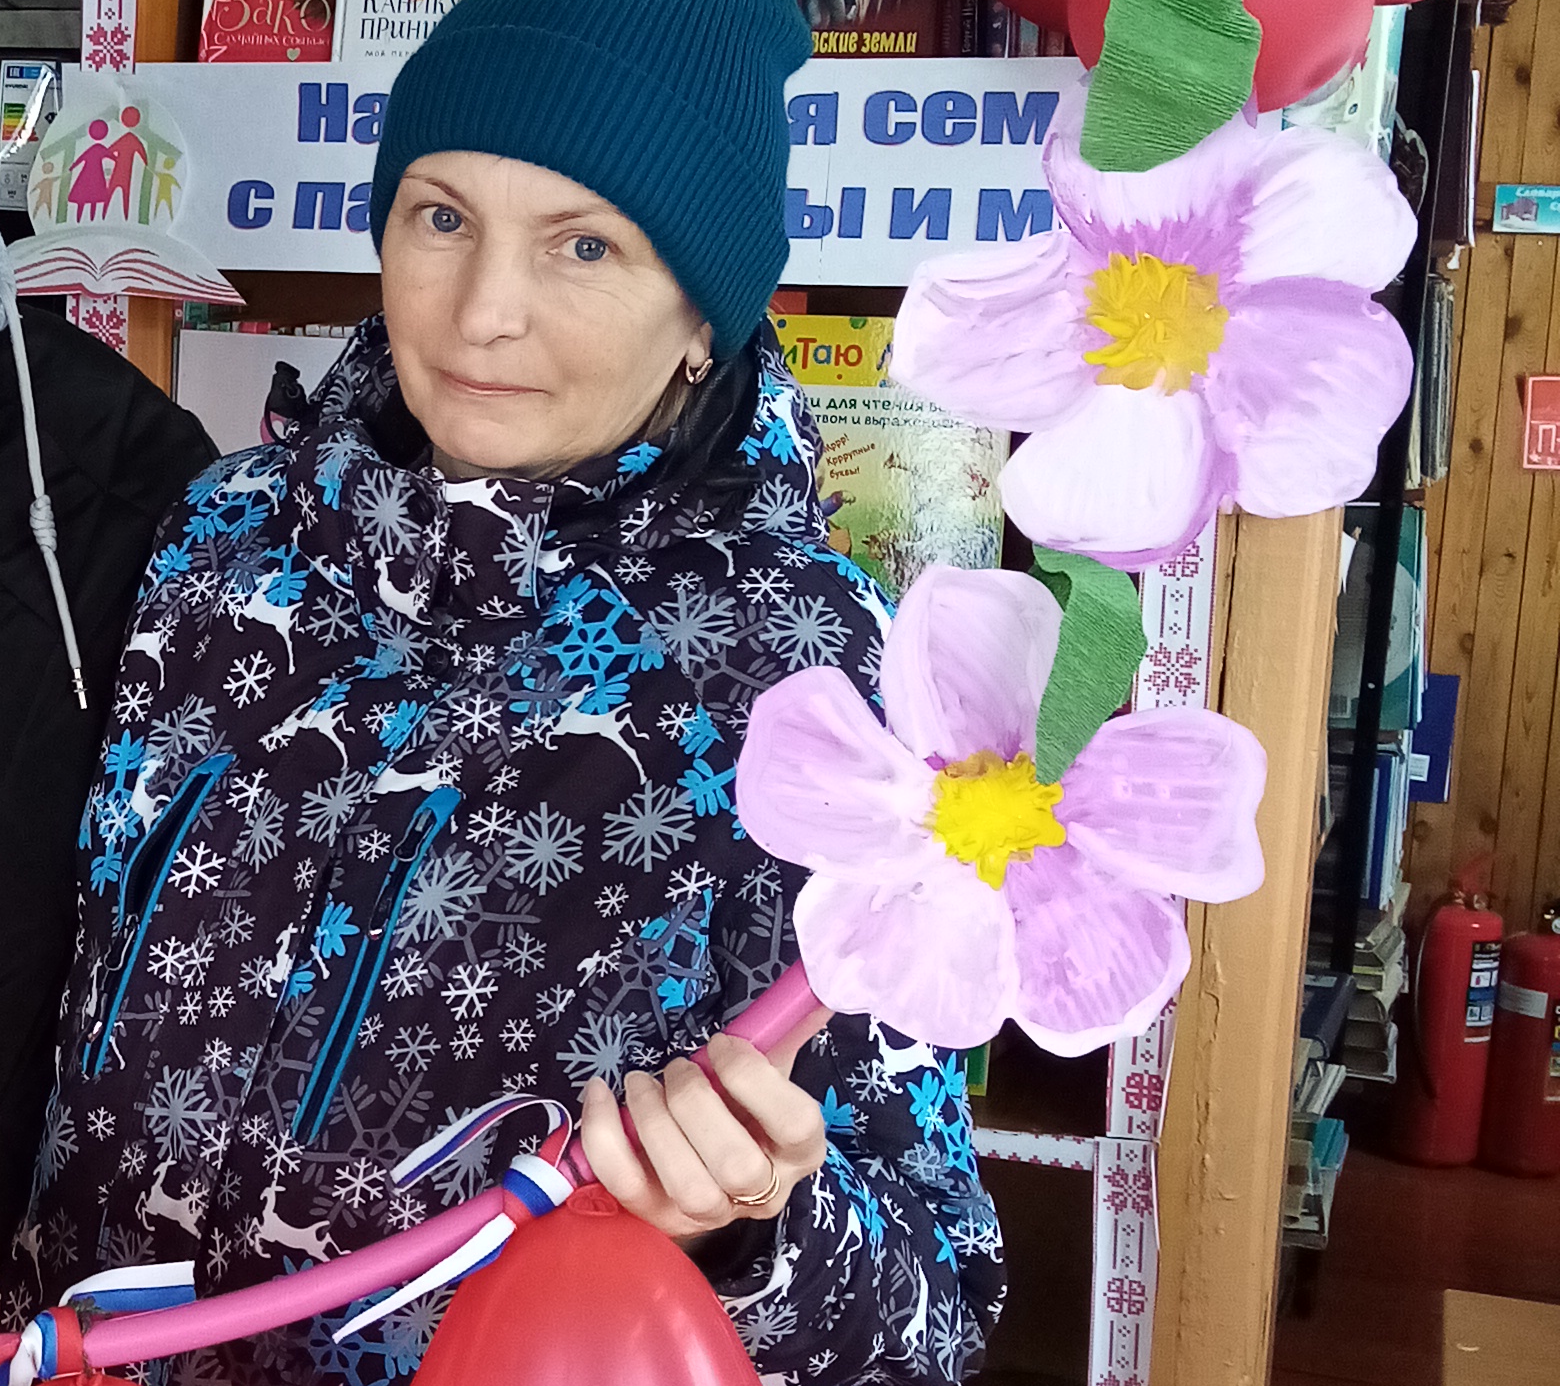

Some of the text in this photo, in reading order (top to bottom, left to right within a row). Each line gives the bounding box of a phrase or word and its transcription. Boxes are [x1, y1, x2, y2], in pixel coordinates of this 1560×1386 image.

[298, 83, 1059, 146] На я сем
[227, 179, 1055, 242] с па ы и м
[783, 337, 863, 370] иТаю
[815, 414, 847, 424] твом
[826, 398, 857, 410] для
[862, 398, 924, 411] чтения
